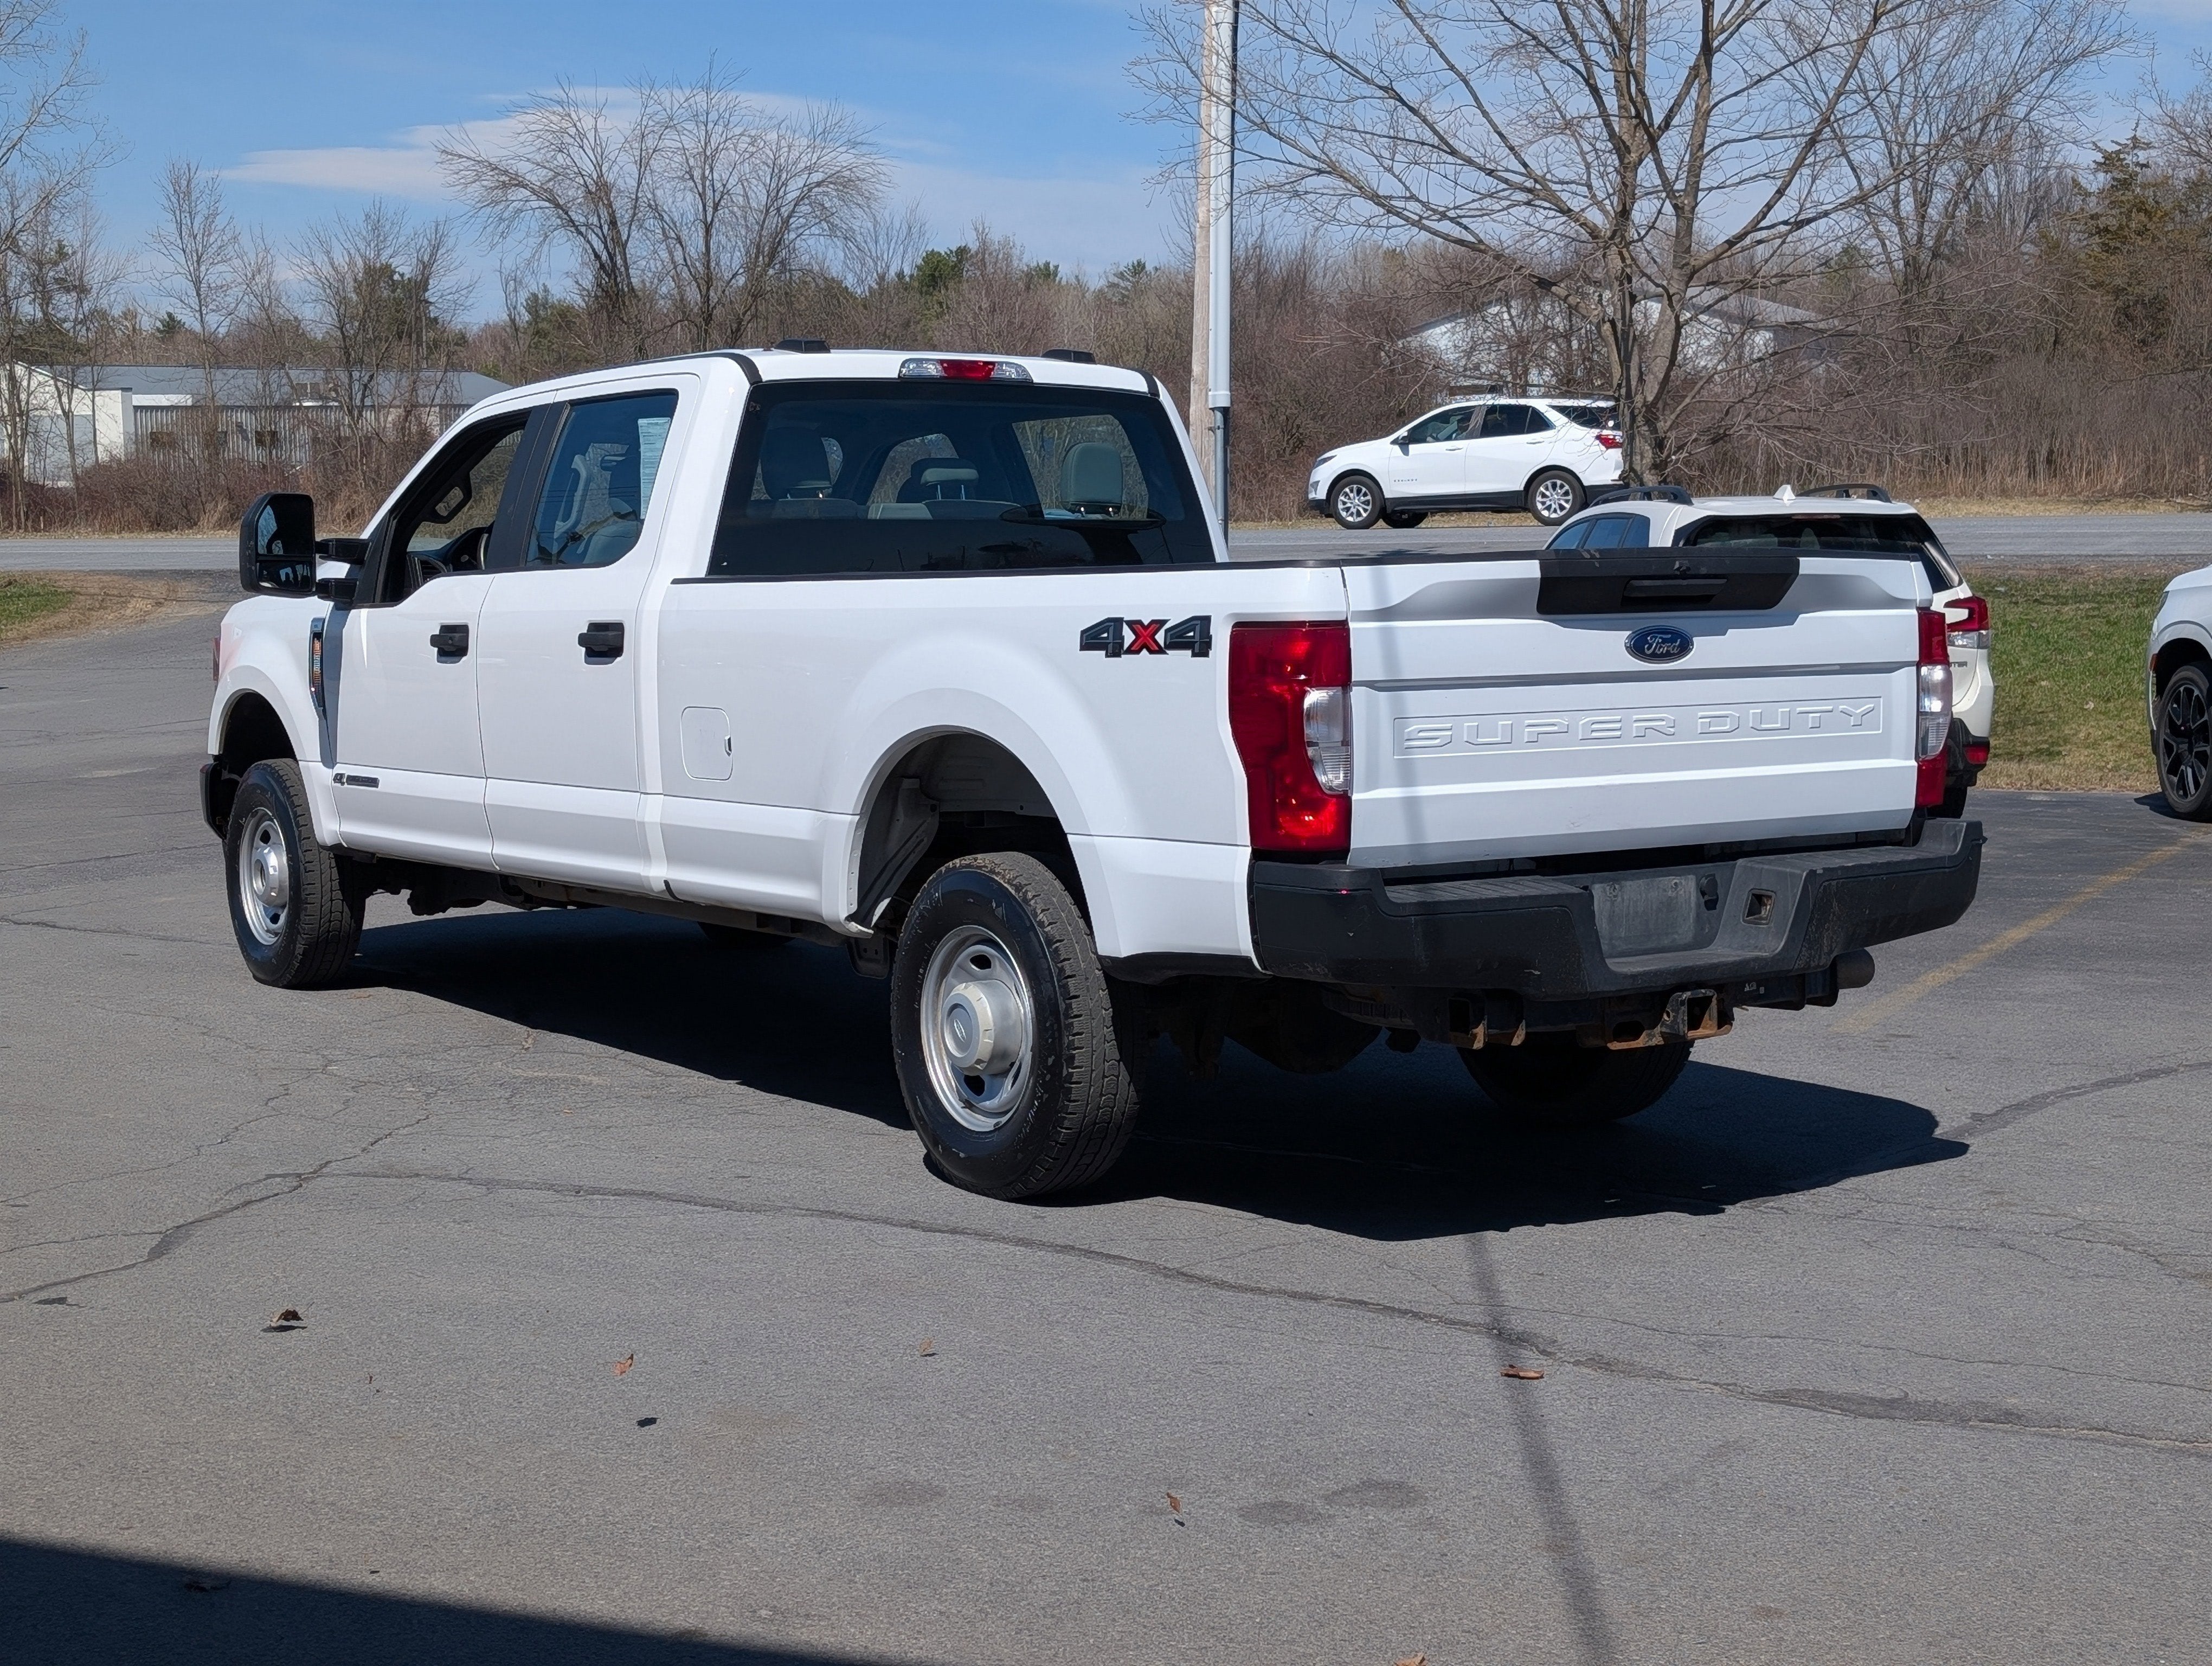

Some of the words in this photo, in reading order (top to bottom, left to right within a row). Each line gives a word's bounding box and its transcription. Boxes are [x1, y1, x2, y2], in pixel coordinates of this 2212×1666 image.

[1644, 634, 1681, 654] Ford
[1404, 714, 1675, 749] SUPER
[1697, 704, 1874, 734] DUTY
